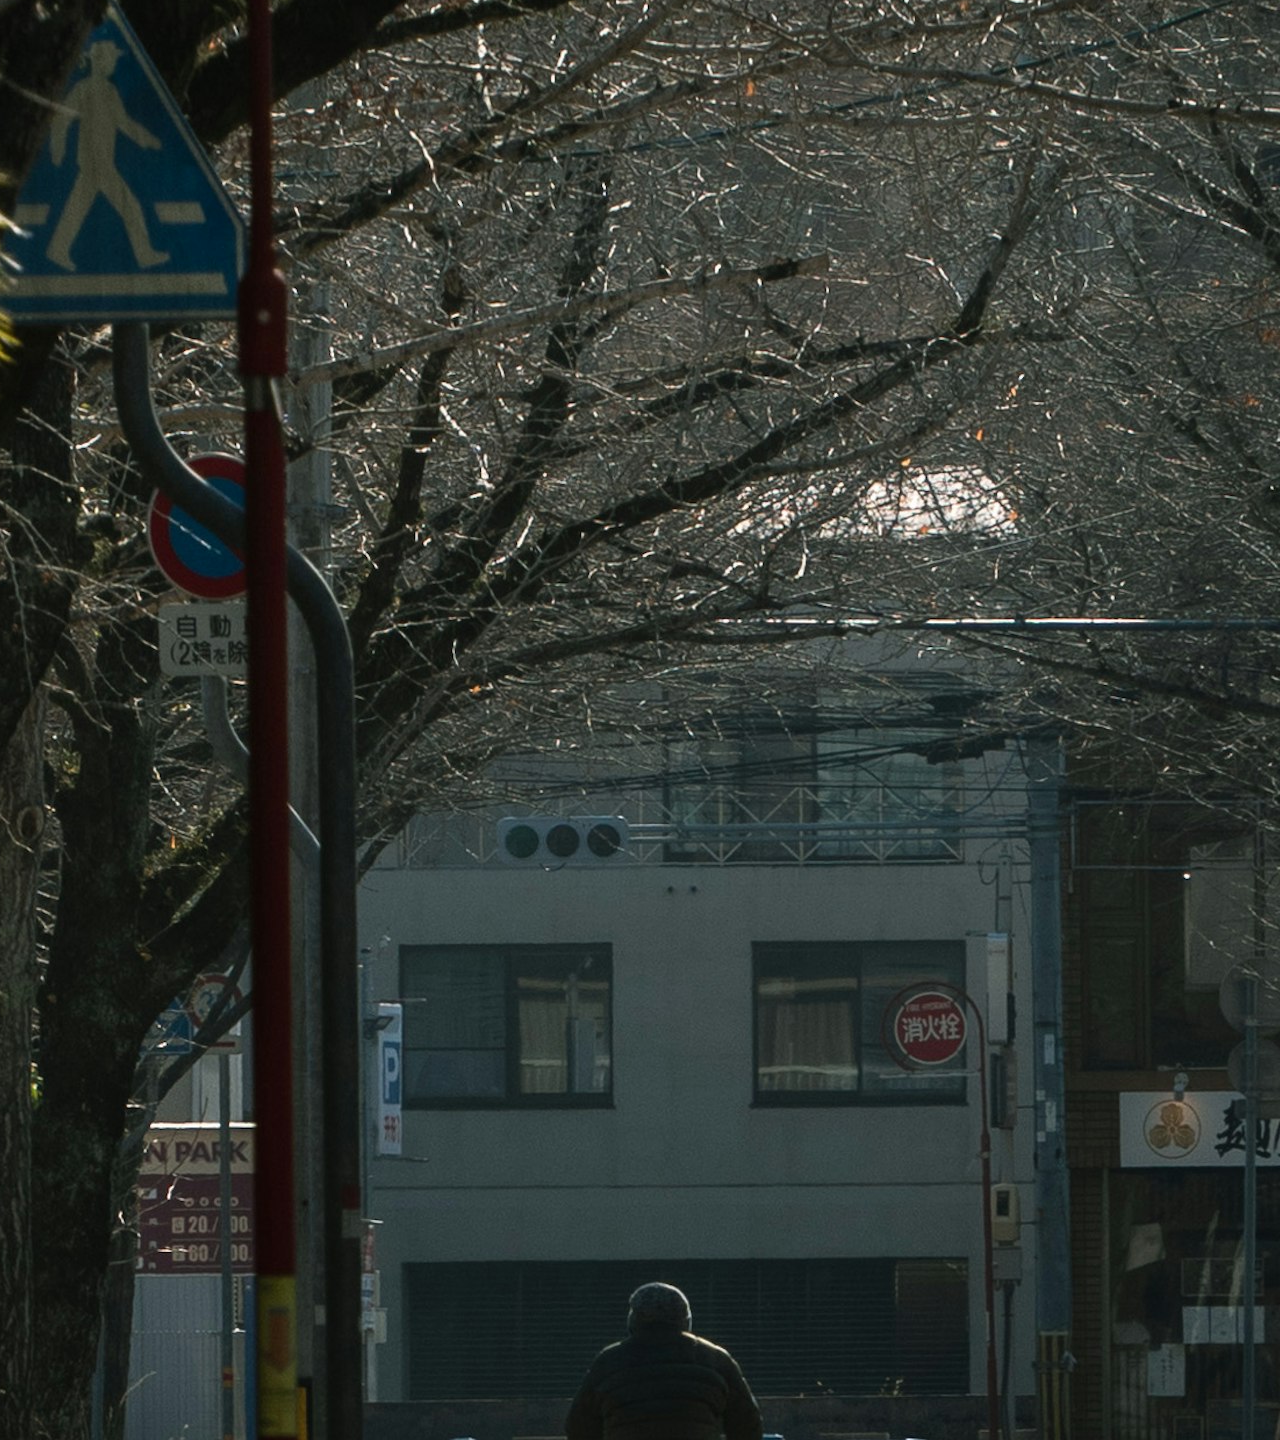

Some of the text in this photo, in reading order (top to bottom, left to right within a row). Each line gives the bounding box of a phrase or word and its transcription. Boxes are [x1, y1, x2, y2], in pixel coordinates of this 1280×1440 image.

[176, 614, 249, 639] 自動
[901, 1012, 962, 1044] 消火栓
[175, 1141, 249, 1162] PARK
